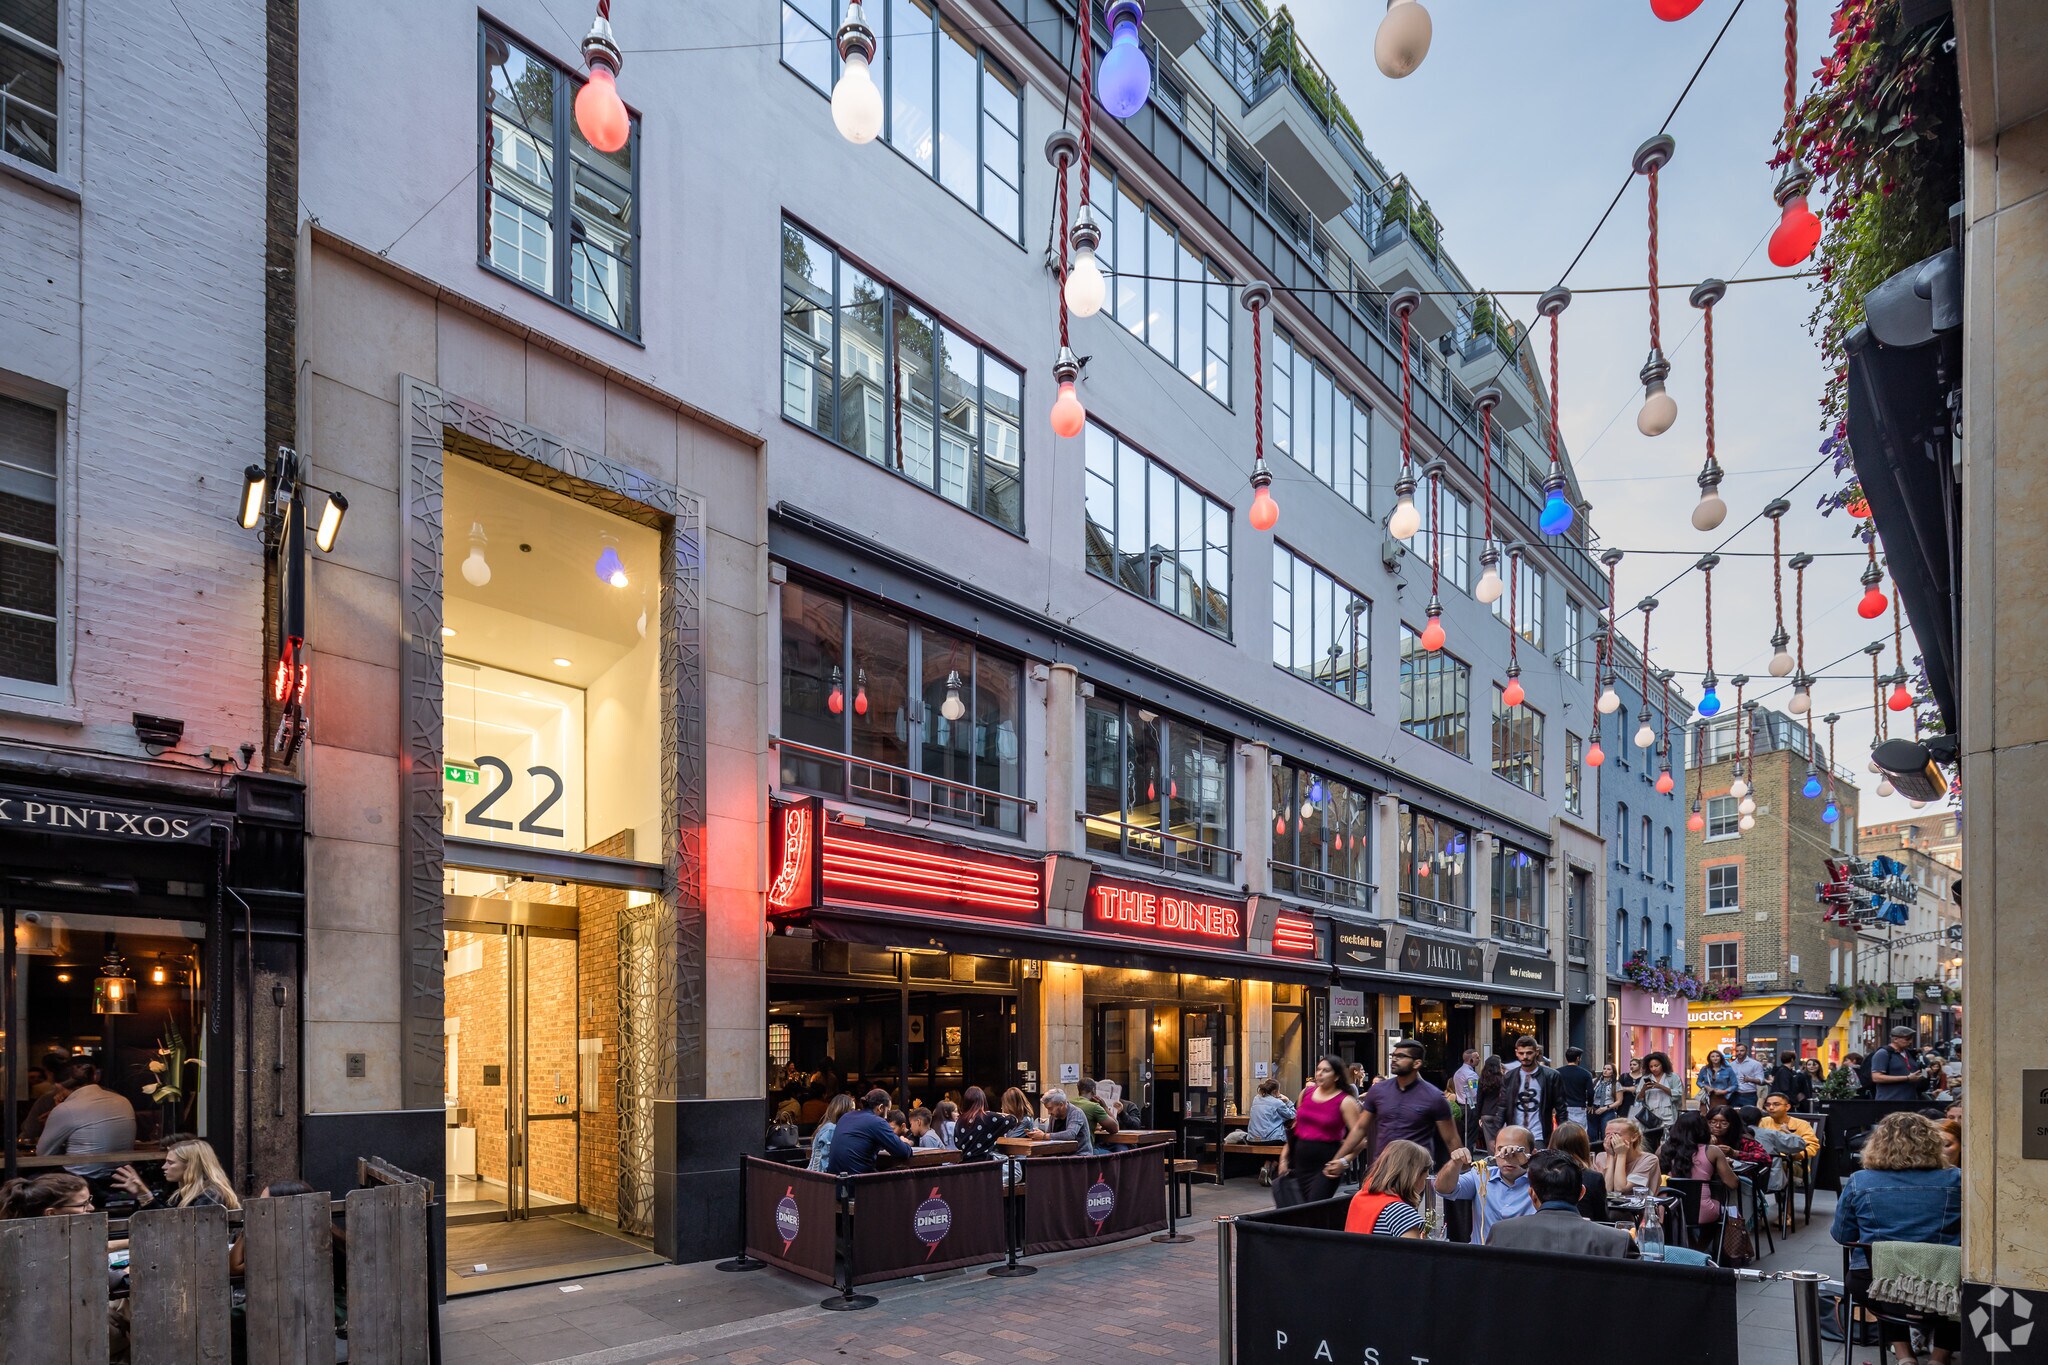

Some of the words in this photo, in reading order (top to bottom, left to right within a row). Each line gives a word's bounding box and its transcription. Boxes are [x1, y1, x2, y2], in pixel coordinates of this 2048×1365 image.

[464, 755, 564, 838] 22
[22, 801, 190, 839] PINTXOS
[1097, 885, 1156, 925] THE
[1161, 897, 1240, 937] DINER
[1339, 934, 1370, 946] cocktail
[1370, 937, 1383, 949] bar
[1426, 944, 1462, 971] JAKATA
[1088, 1196, 1112, 1207] DINER
[778, 1211, 798, 1226] DINER
[917, 1214, 949, 1227] DINER
